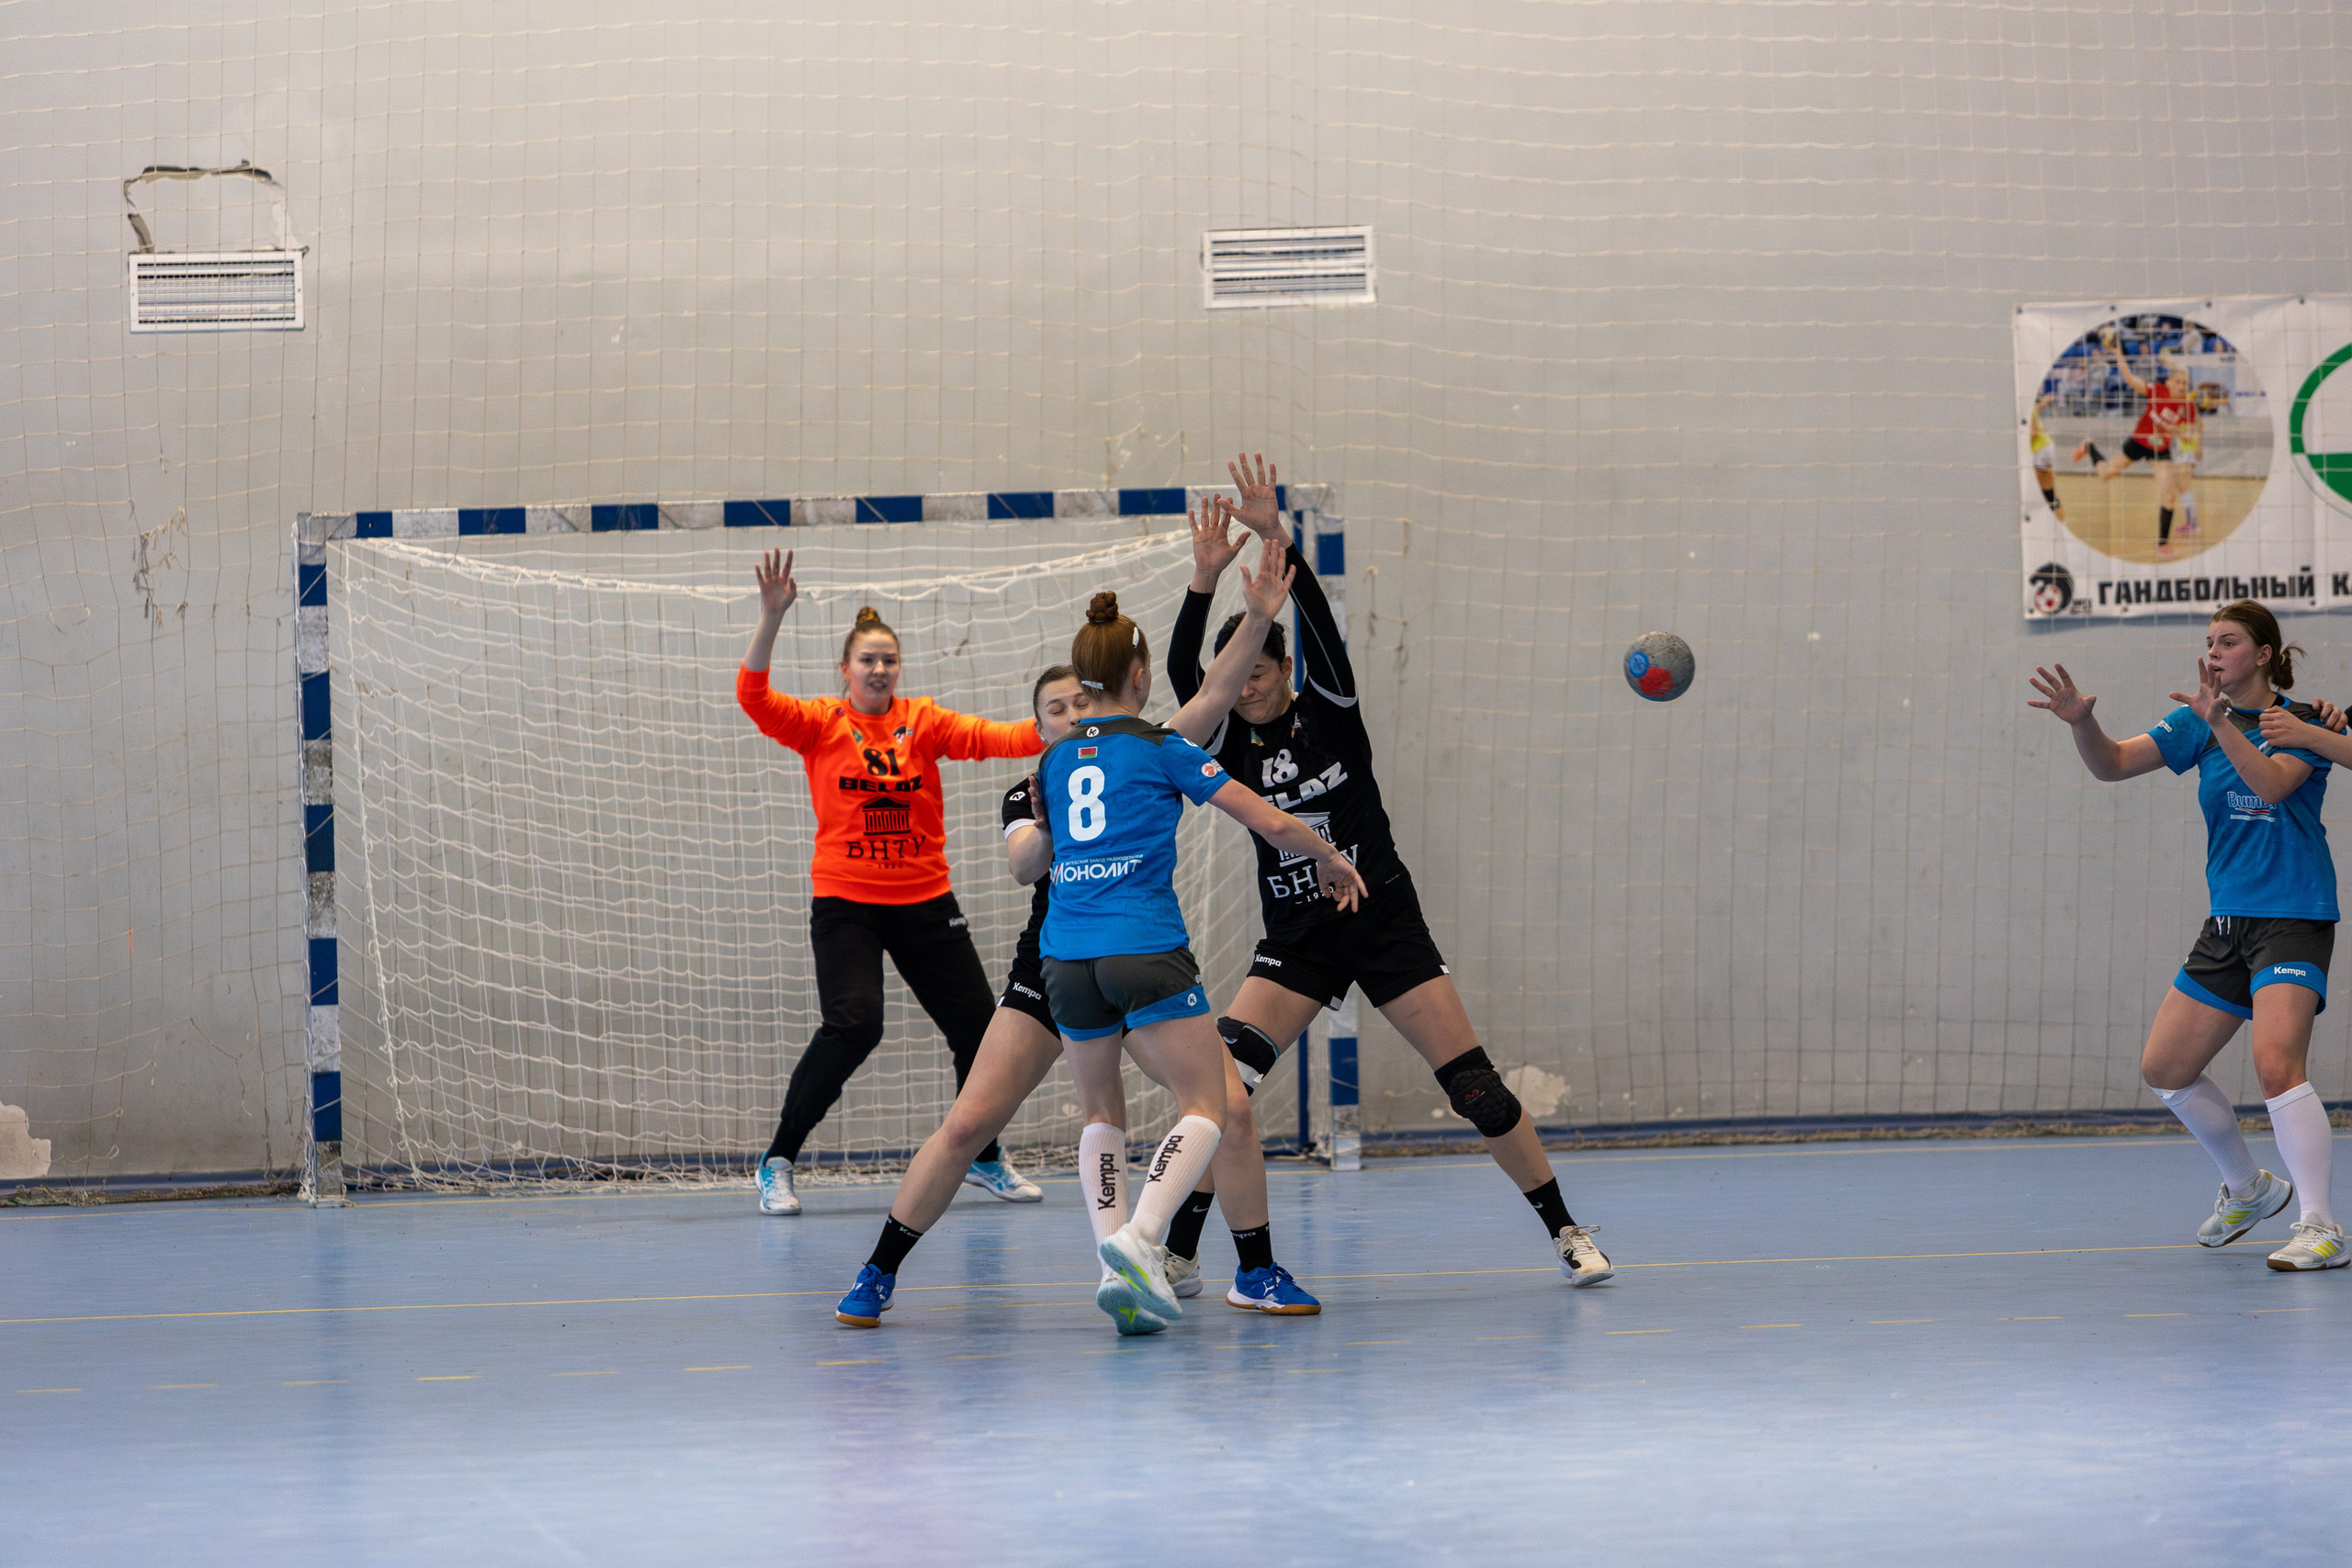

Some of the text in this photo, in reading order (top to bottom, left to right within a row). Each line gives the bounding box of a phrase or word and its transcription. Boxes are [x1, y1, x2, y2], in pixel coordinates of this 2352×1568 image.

[2098, 566, 2352, 605] ГАНДБОЛЬНЫЙ К
[864, 748, 900, 776] 81
[1261, 749, 1299, 788] 18
[839, 774, 923, 793] BELAZ
[1068, 765, 1106, 841] 8
[845, 835, 927, 861] БНТУ
[1267, 844, 1359, 898] БНУ
[1254, 953, 1283, 967] Kempa
[2274, 966, 2307, 977] Kempa
[1012, 982, 1042, 1000] Kempa
[1147, 1135, 1184, 1184] Kempa
[1097, 1153, 1120, 1211] Kempa
